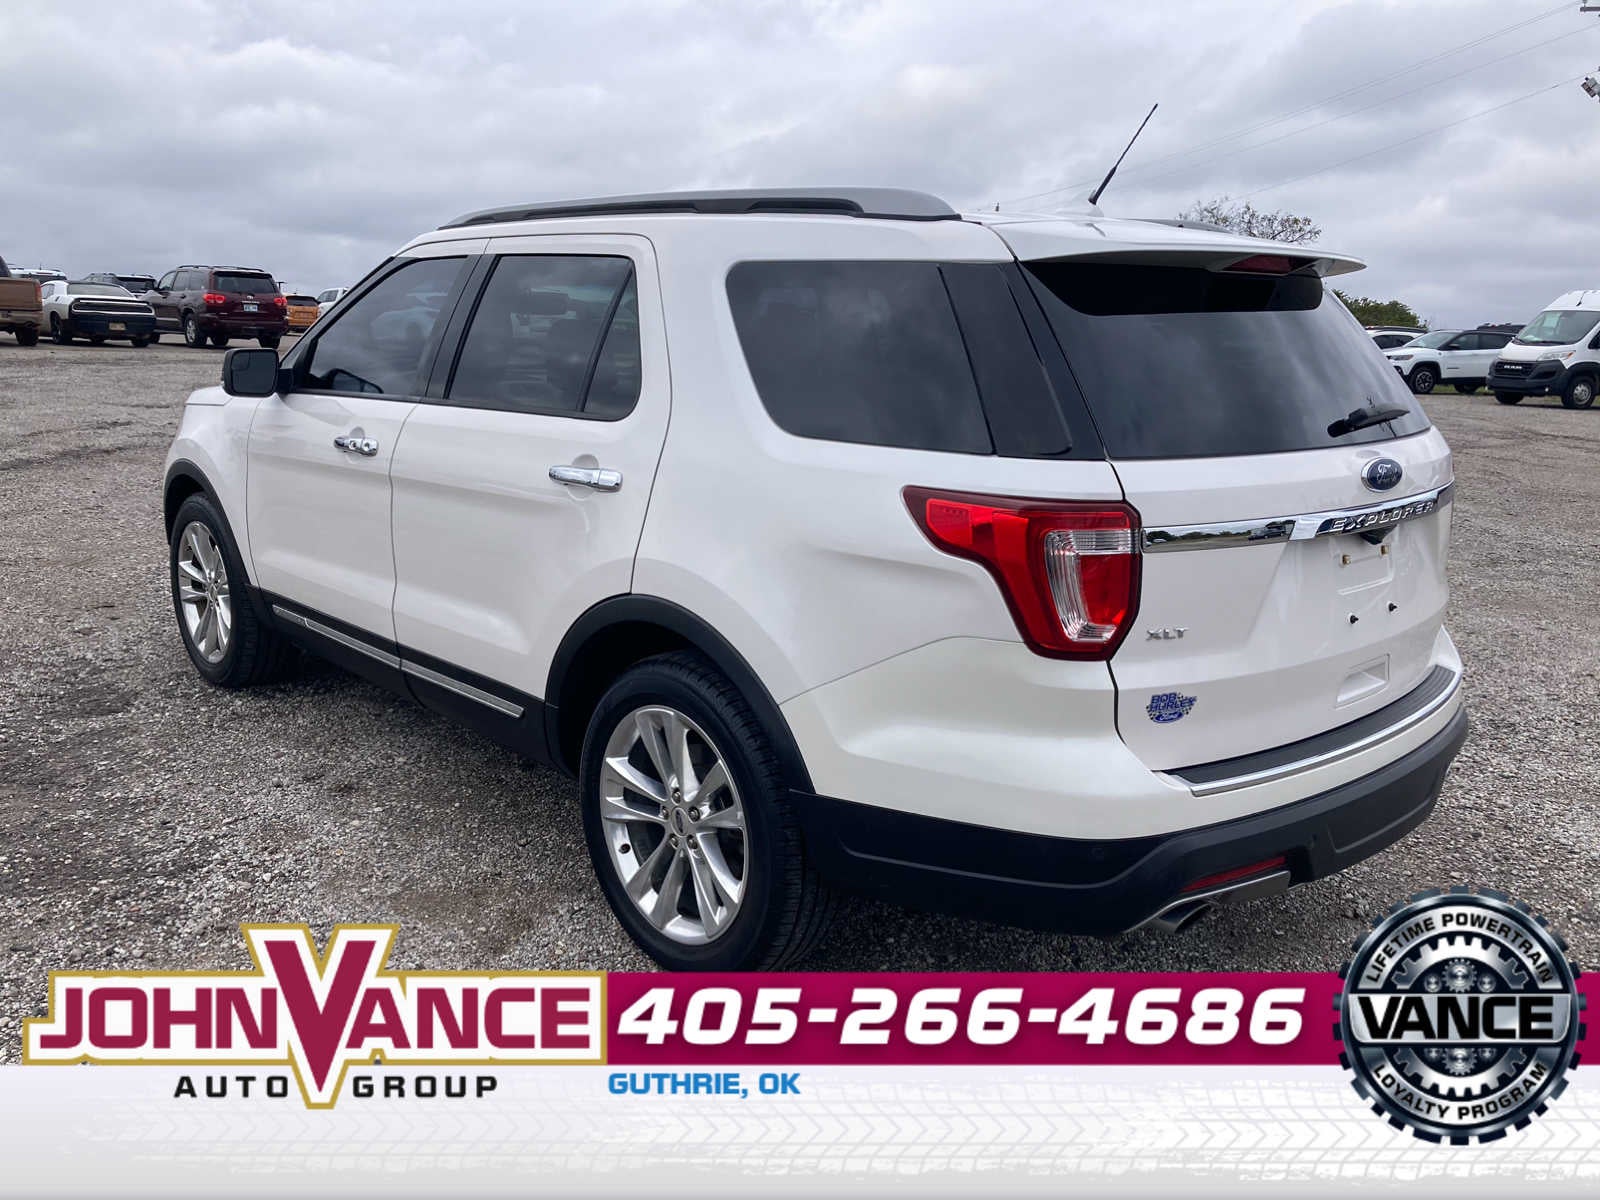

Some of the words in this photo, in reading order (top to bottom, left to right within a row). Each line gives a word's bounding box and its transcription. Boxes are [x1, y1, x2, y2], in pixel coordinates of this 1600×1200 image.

[1332, 501, 1435, 531] EXPLORER
[1146, 627, 1190, 641] XLT
[1151, 692, 1178, 705] BOB
